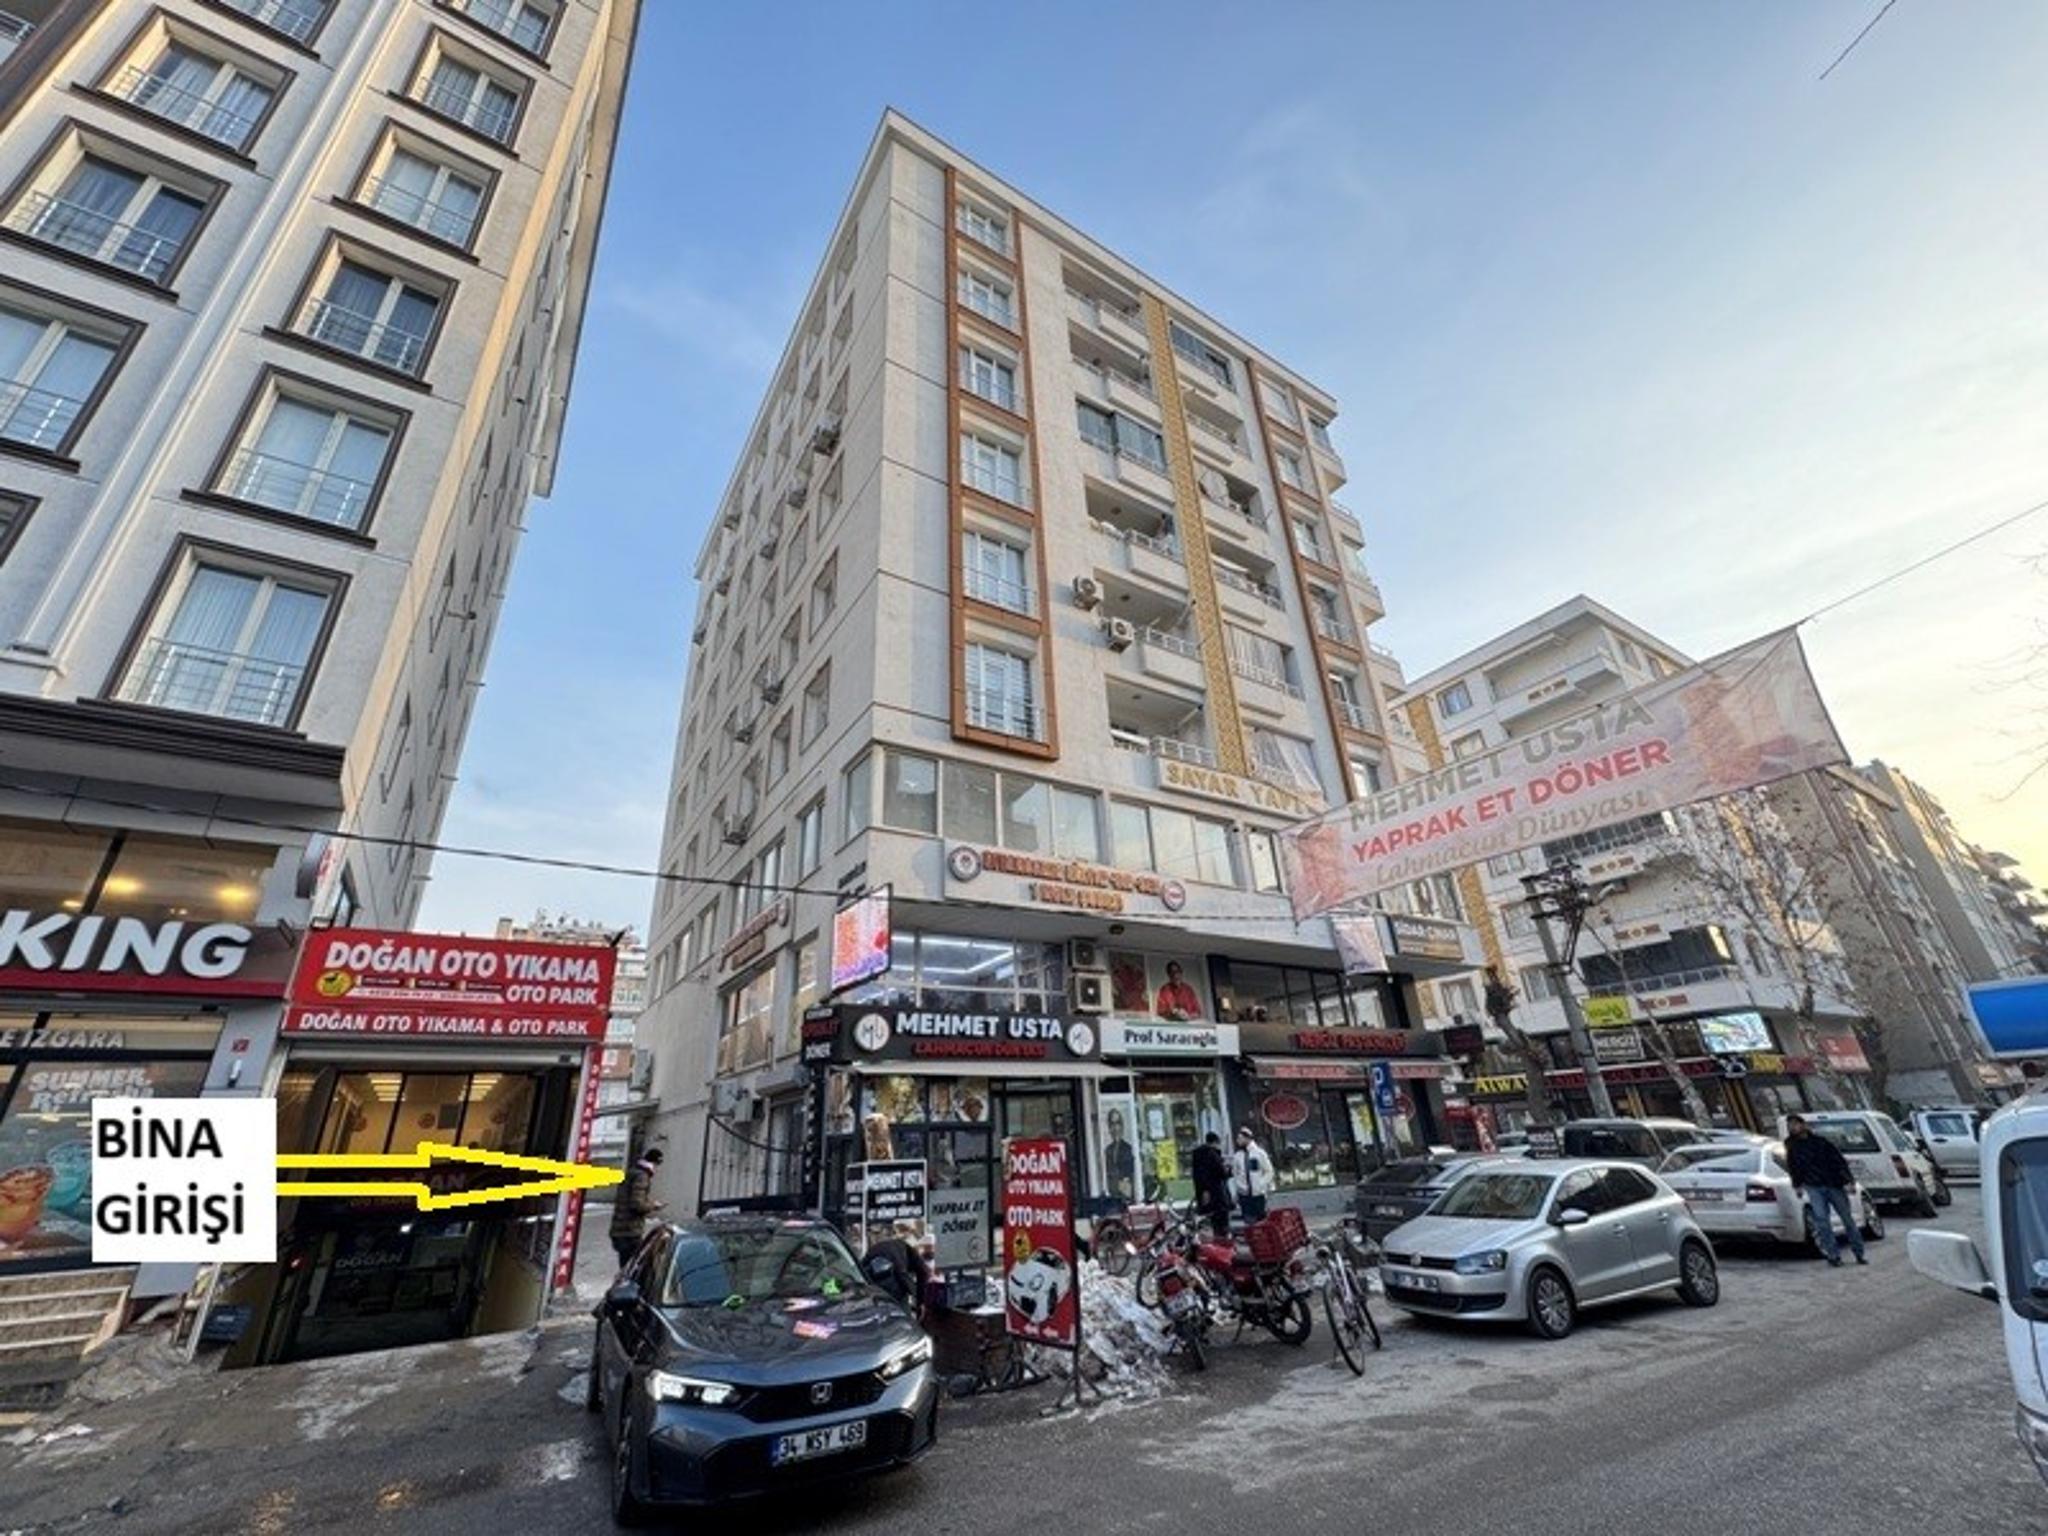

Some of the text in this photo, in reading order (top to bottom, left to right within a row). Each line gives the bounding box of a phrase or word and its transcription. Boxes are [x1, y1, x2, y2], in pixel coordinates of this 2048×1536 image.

[1350, 696, 1655, 832] MEHMET USTA
[1351, 739, 1674, 863] YAPRAK ET DÖNER
[1374, 787, 1652, 888] Lahmacun Dünyası
[0, 908, 253, 979] KING
[325, 938, 600, 984] DOĞAN OTO YIKAMA
[506, 985, 546, 1004] OTO
[550, 987, 598, 1006] PARK
[299, 1009, 588, 1035] DOĞAN OTO YIKAMA & OTO PARK
[896, 1011, 1063, 1039] MEHMET USTA
[1124, 1028, 1153, 1043] Prof
[1007, 1206, 1066, 1227] OTO PARK
[780, 1436, 797, 1458] 34
